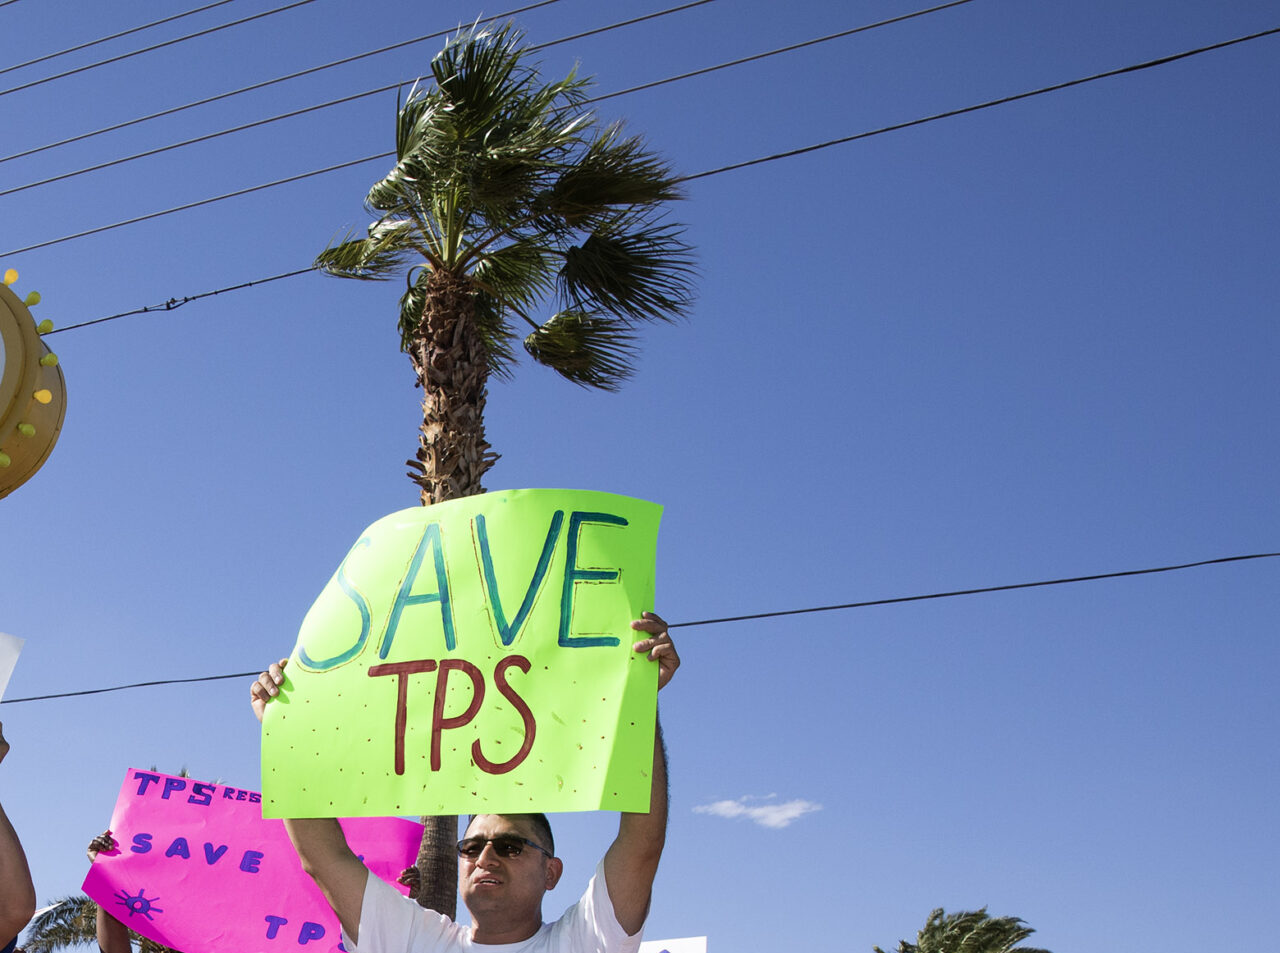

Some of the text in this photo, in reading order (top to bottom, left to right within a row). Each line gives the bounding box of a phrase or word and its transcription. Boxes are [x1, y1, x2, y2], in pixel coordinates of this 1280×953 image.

[297, 509, 629, 672] SAVE
[367, 654, 537, 776] TPS
[134, 771, 217, 806] TPS
[130, 832, 265, 874] SAVE
